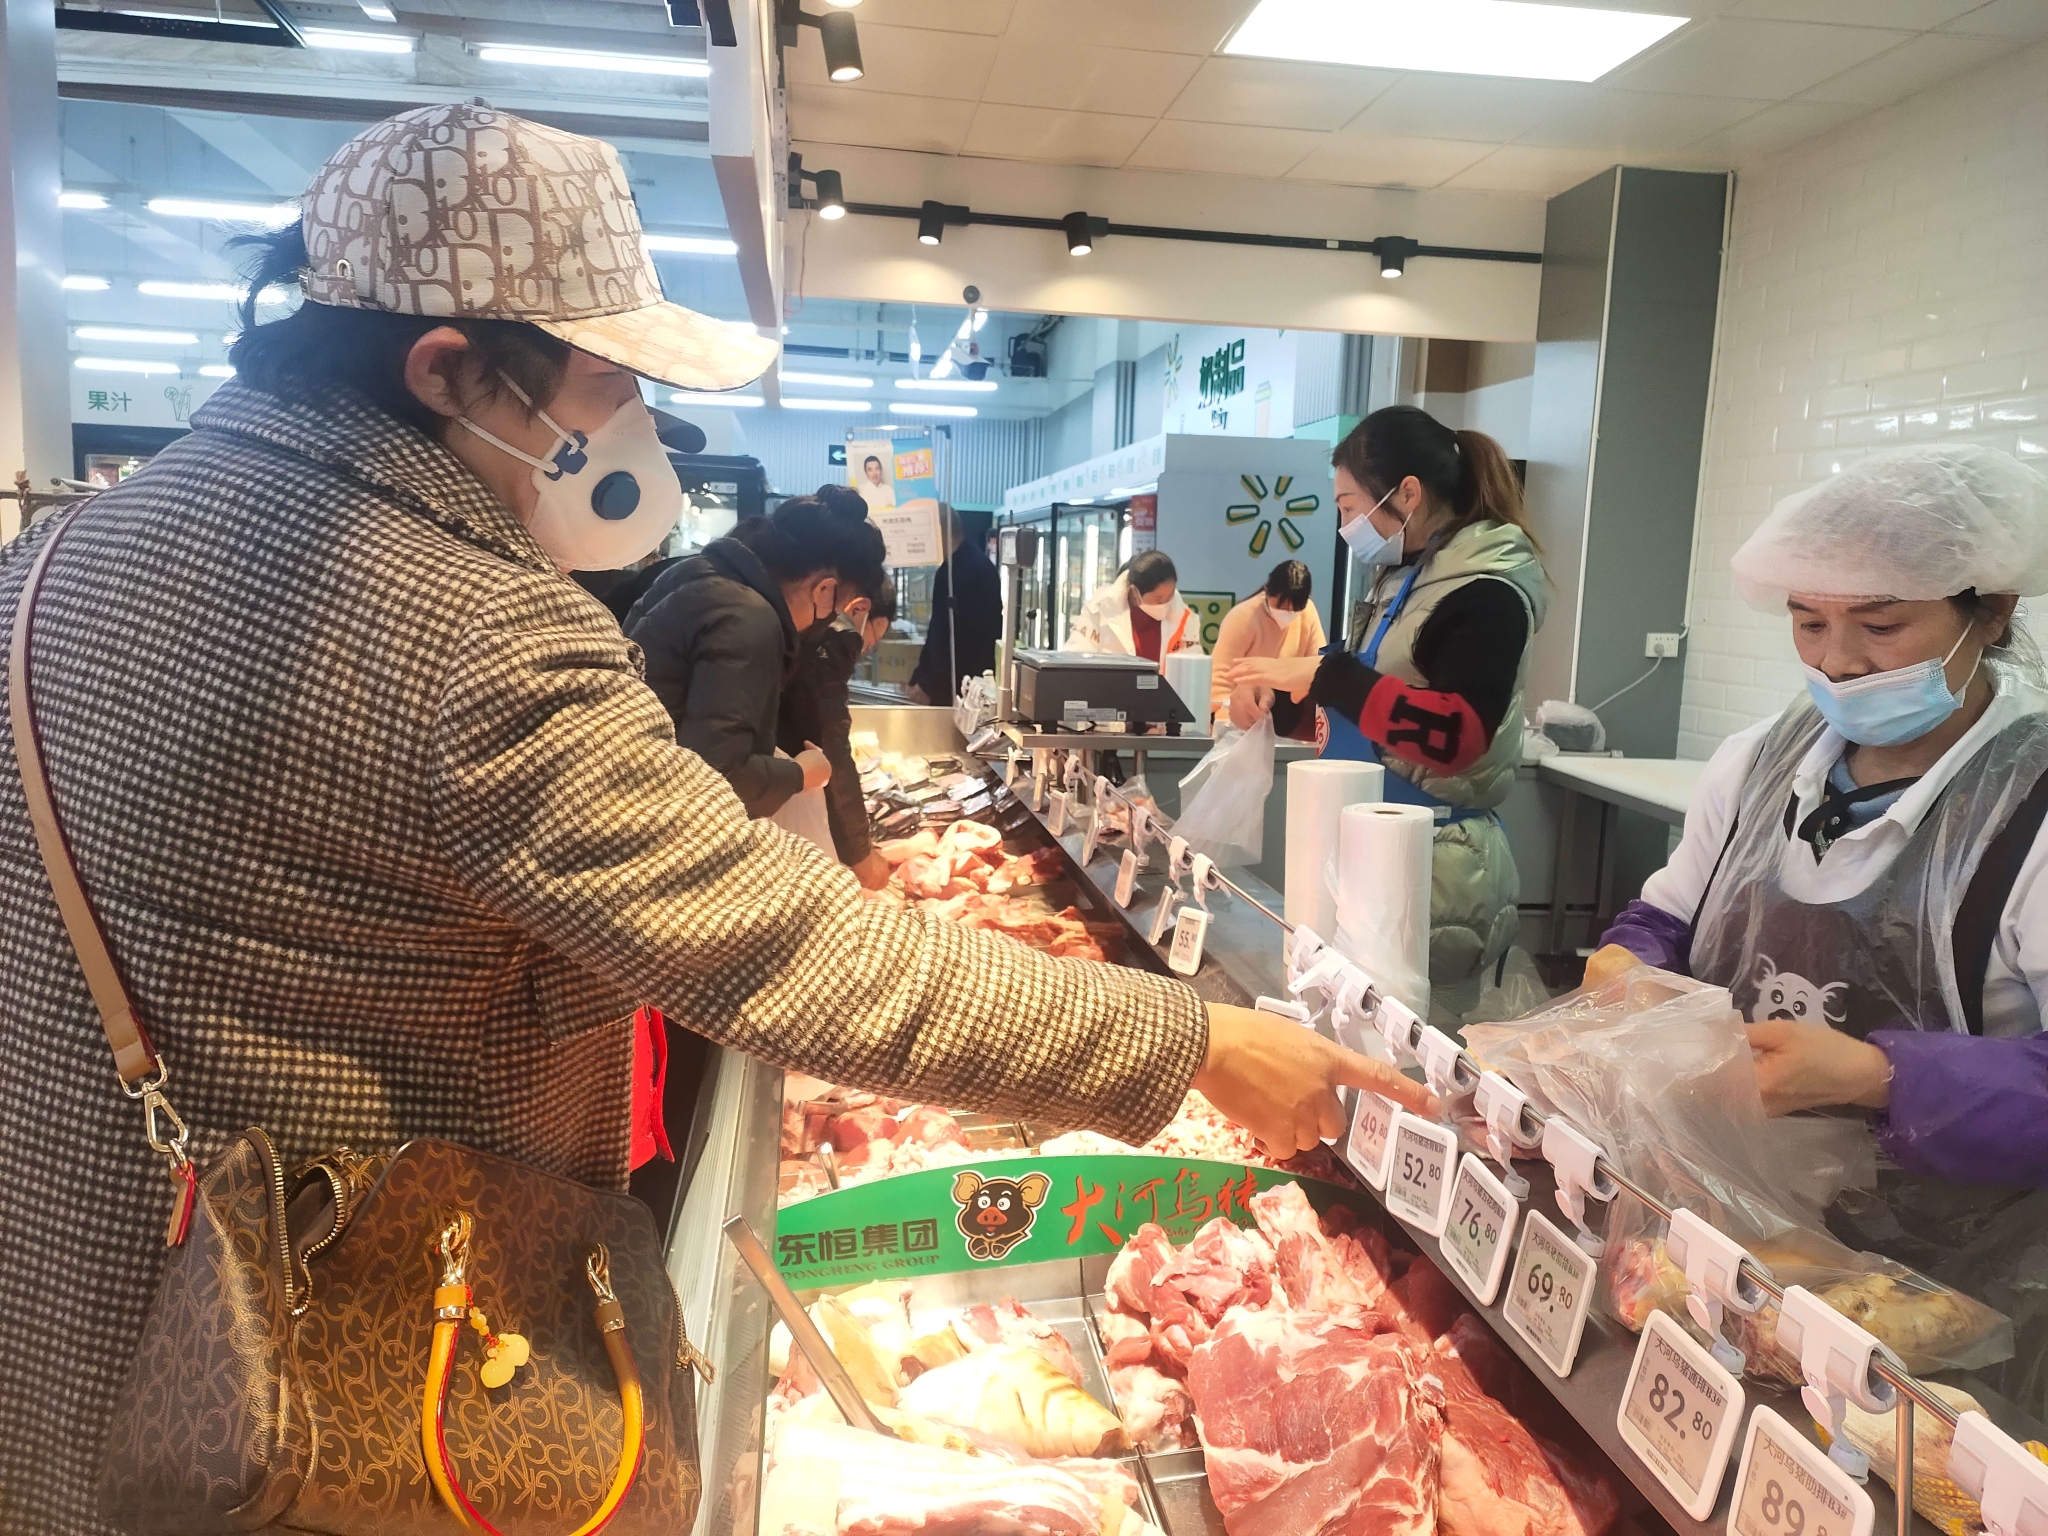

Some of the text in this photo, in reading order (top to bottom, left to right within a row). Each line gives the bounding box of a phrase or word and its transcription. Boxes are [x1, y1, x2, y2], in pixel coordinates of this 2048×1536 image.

[88, 390, 132, 412] 果汁
[778, 1218, 939, 1267] 东恒集团
[881, 1254, 941, 1270] GROUP
[1655, 1336, 1722, 1407] 大河乌猪通排B3#
[1763, 1437, 1848, 1520] 大河乌猪肋排B3#
